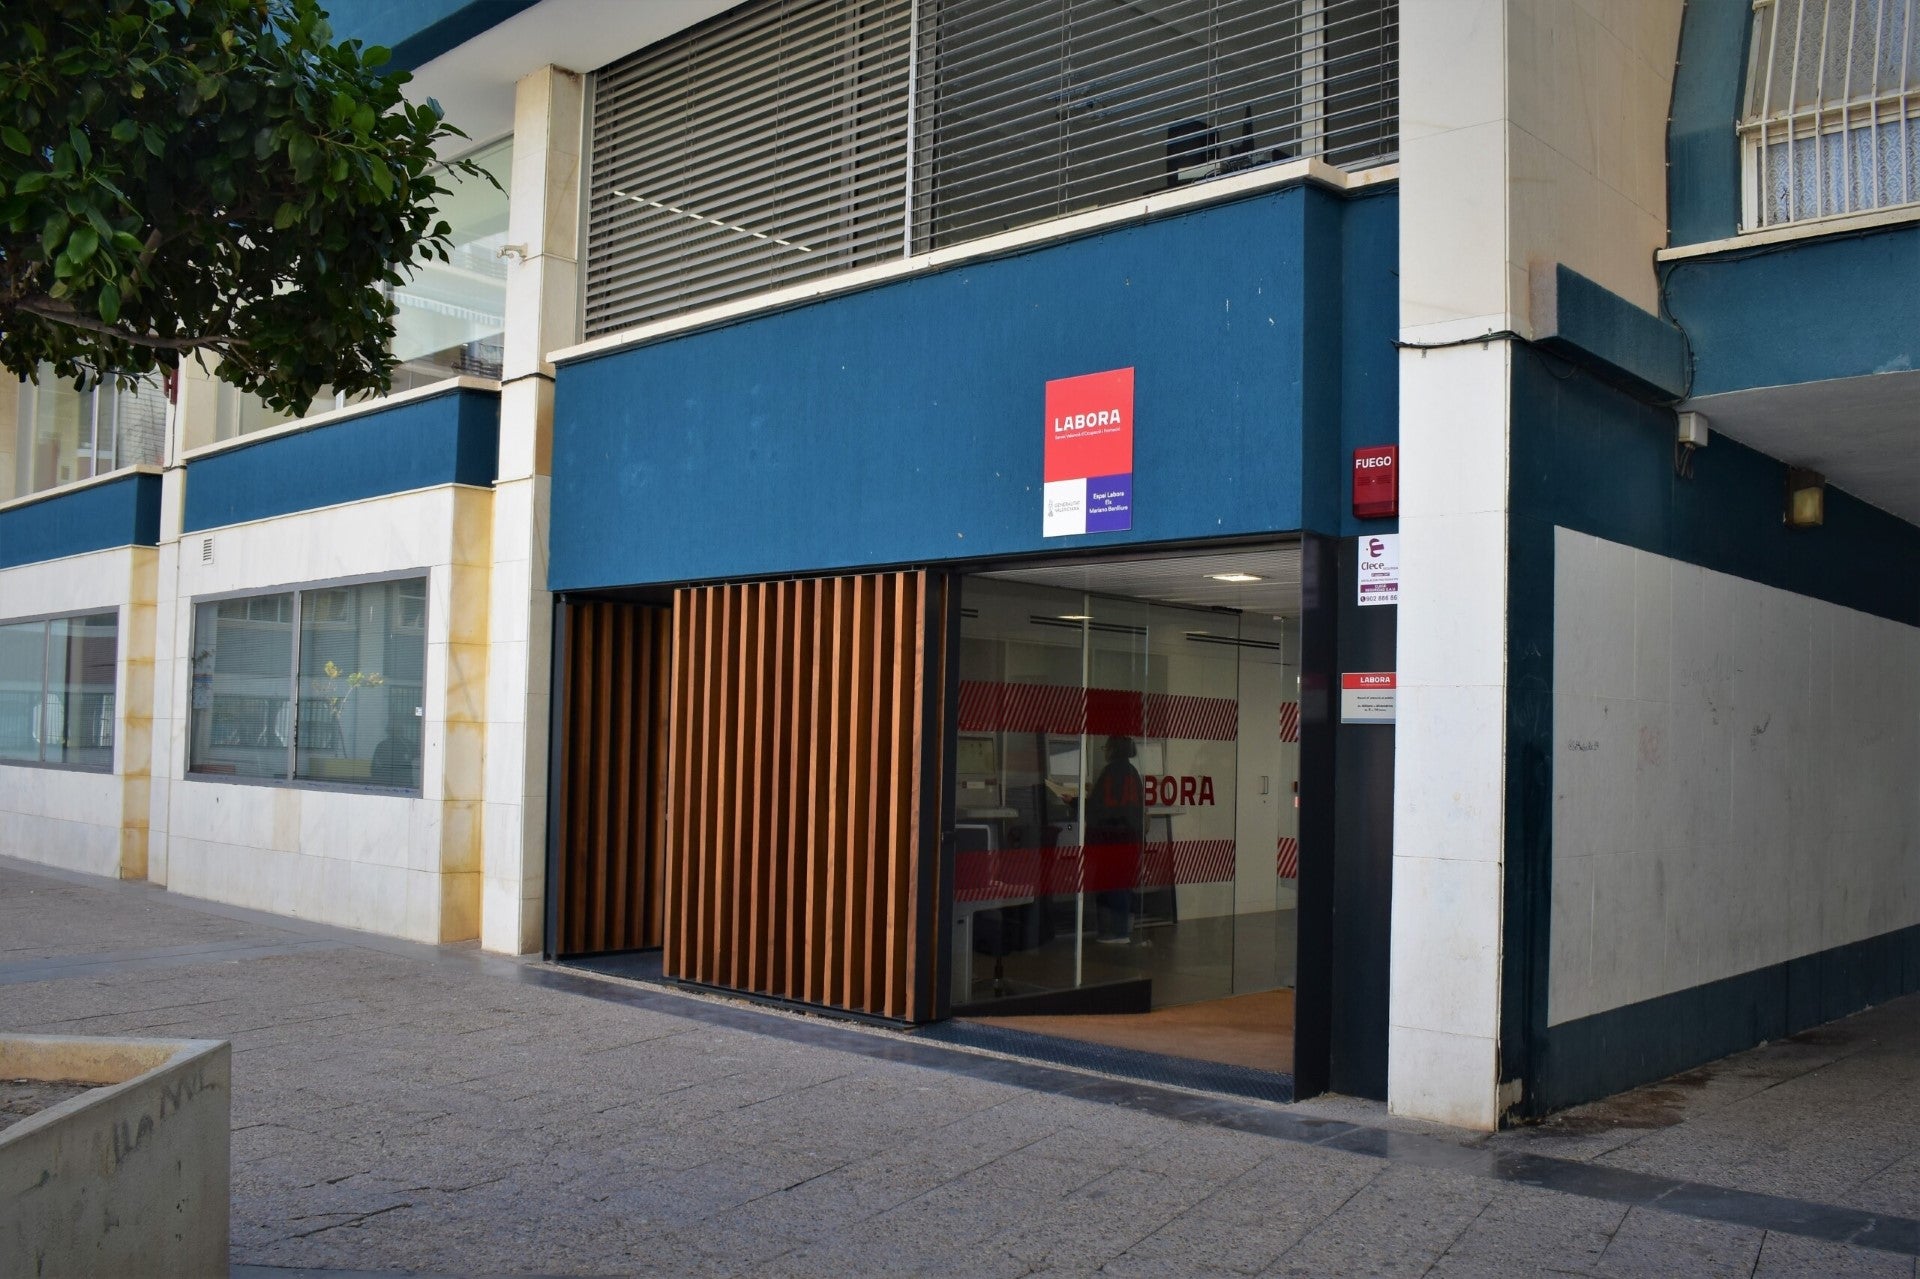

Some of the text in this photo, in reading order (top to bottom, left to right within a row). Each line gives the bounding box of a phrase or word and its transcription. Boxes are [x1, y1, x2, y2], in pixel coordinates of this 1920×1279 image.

[1055, 408, 1121, 433] LABORA
[1355, 456, 1392, 469] FUEGO
[1107, 491, 1124, 499] Labora
[1361, 562, 1385, 570] Clece
[1103, 775, 1216, 807] LABORA
